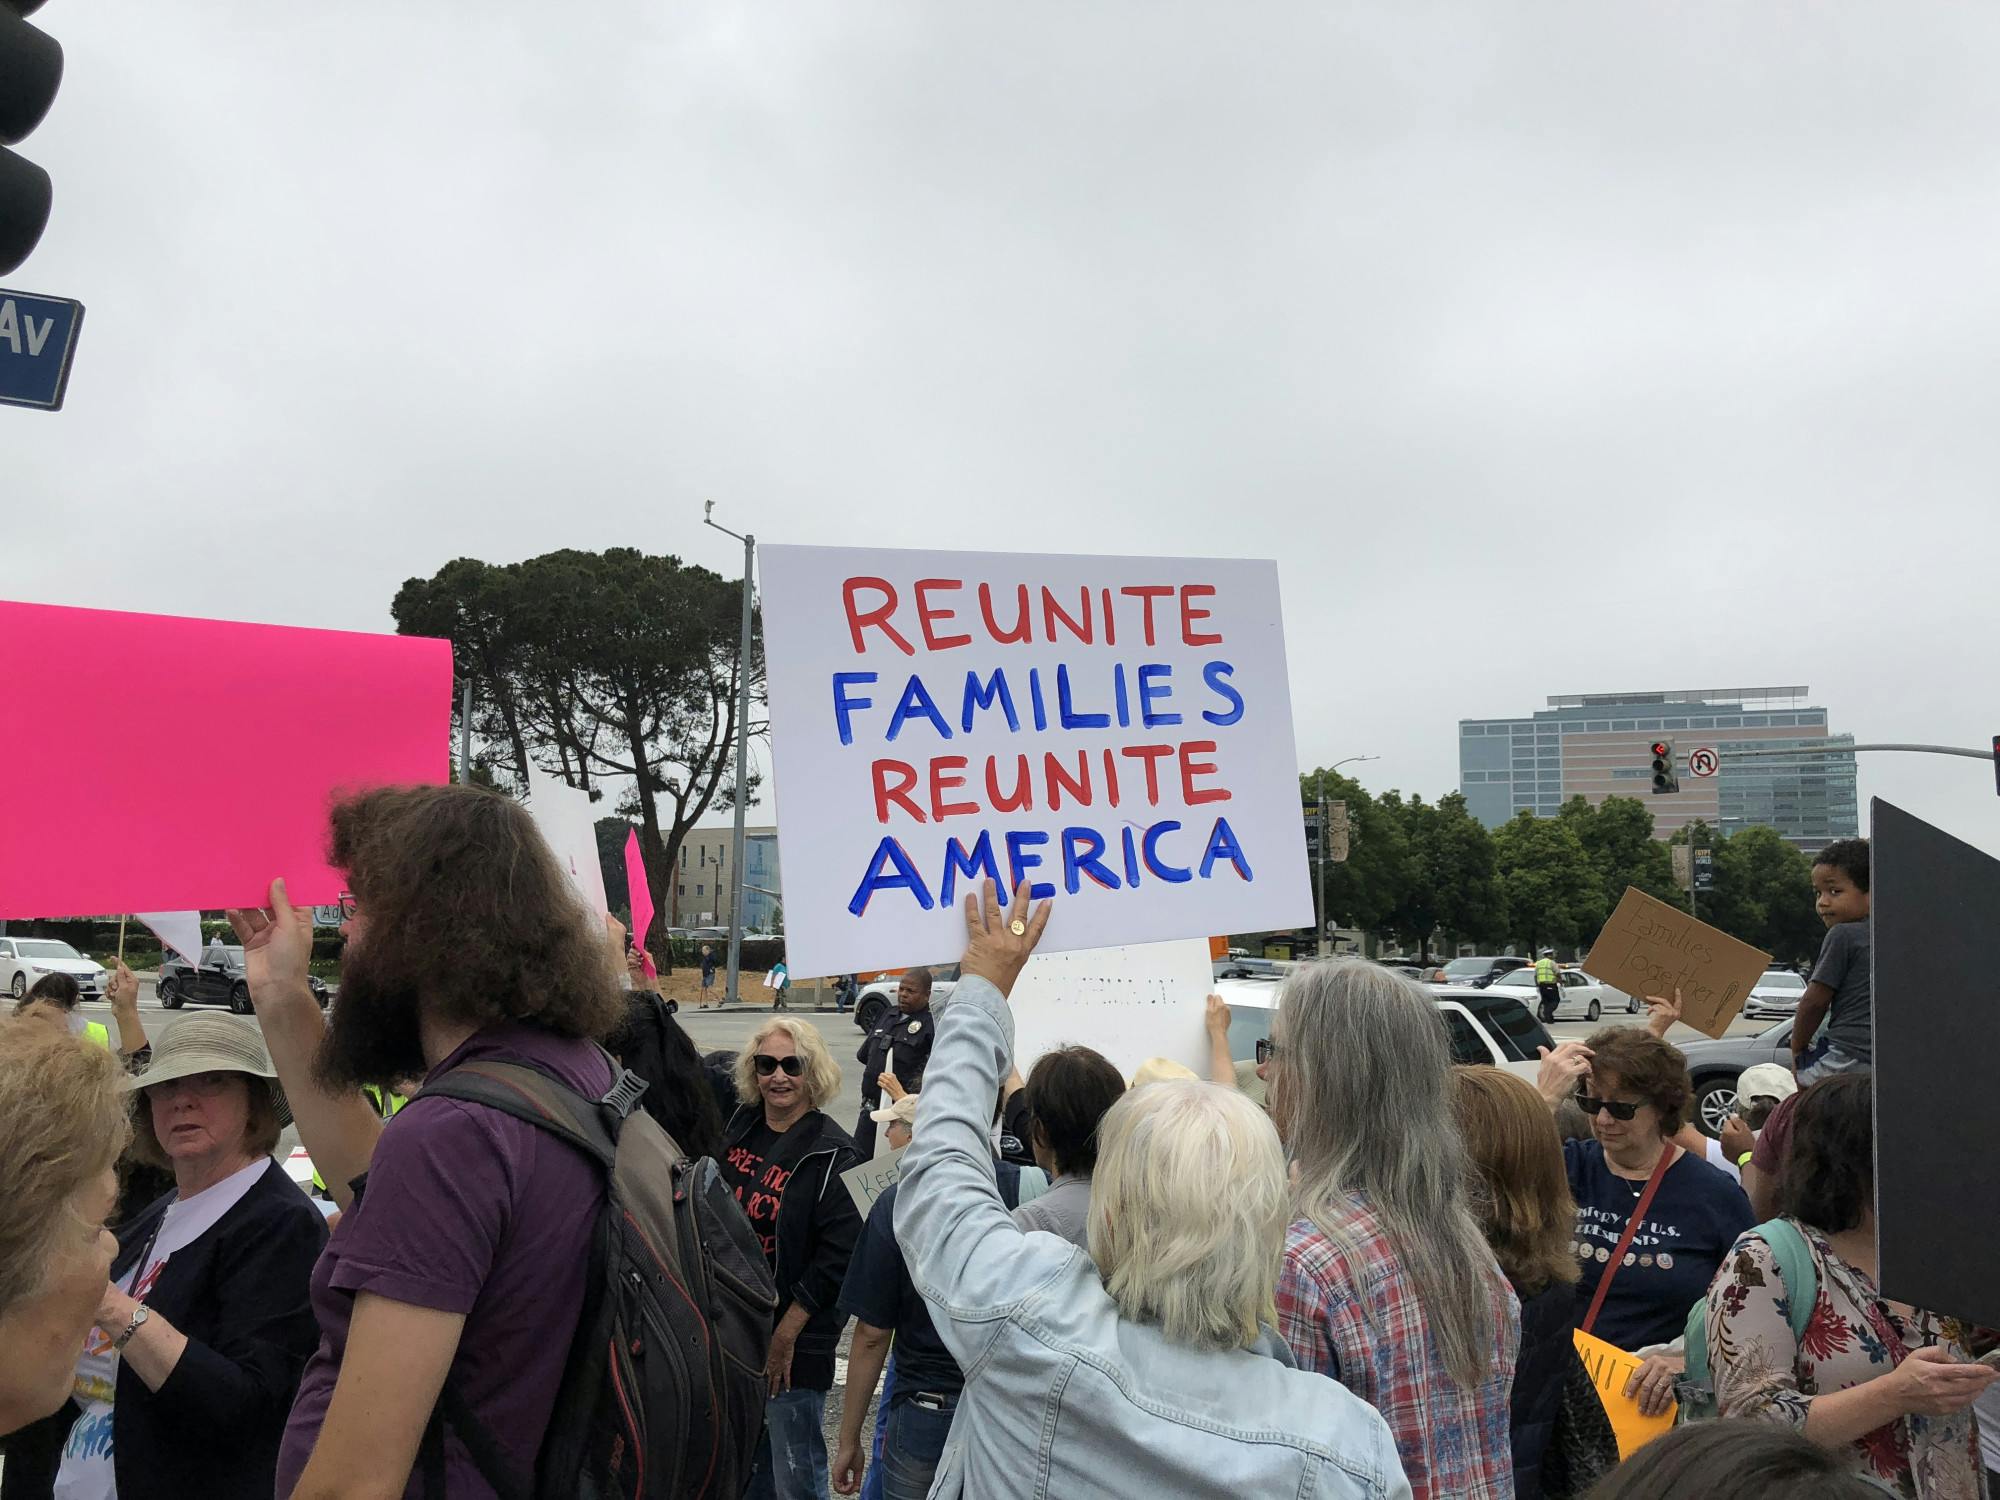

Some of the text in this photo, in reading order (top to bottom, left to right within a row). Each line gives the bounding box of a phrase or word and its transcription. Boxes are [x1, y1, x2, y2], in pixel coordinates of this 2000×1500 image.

[842, 575, 1224, 657] REUNITE
[831, 659, 1246, 748] FAMILIES
[871, 739, 1233, 825] REUNITE
[847, 815, 1255, 919] AMERICA
[1628, 900, 1714, 965] Families
[1650, 1222, 1681, 1237] U.S.
